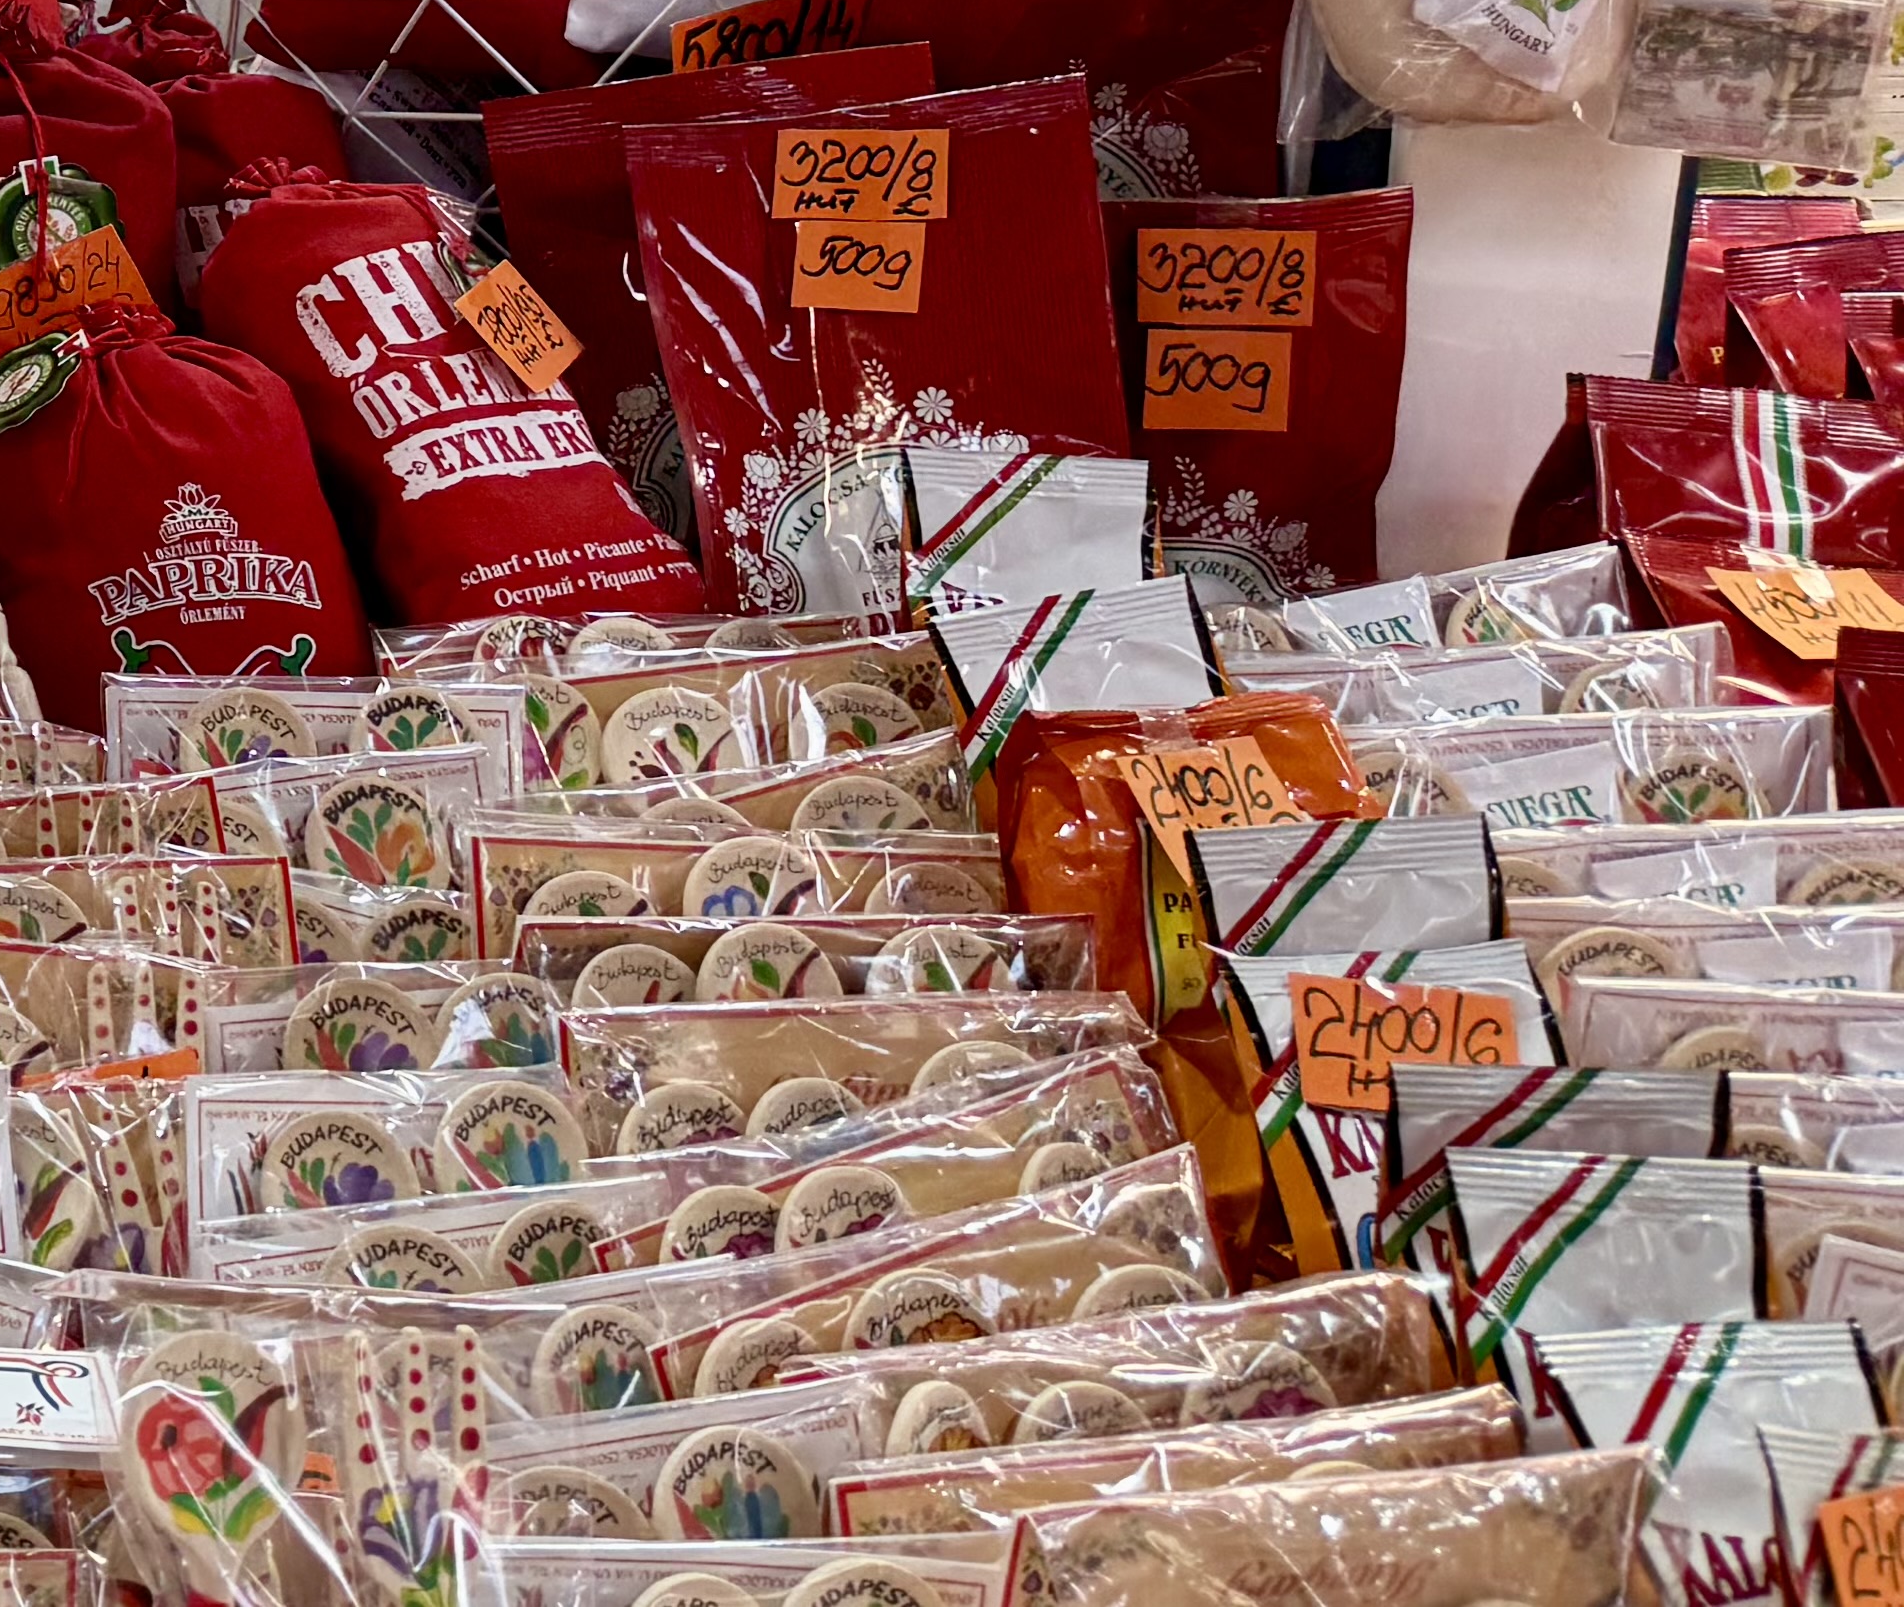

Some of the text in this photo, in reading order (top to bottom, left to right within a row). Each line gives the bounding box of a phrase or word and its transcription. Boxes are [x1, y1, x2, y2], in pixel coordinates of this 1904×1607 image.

[1480, 0, 1559, 58] HUNGARY
[779, 134, 942, 194] 3200/8
[799, 239, 913, 291] 500g
[1137, 236, 1310, 309] 3200/8
[1144, 345, 1273, 414] 500g
[421, 422, 541, 478] EXTRA
[166, 516, 235, 537] HUNGARY
[536, 547, 572, 569] Hot
[583, 538, 647, 564] Picante
[588, 563, 658, 592] Piquant
[88, 550, 322, 626] PAPRIKA
[494, 574, 575, 610] Острый
[180, 605, 246, 626] ŐRLEMÉNY
[201, 699, 297, 744] BUDAPEST
[320, 782, 427, 829] BUDAPEST
[1638, 765, 1744, 803] BUDAPEST
[1555, 943, 1666, 977] BUDAPEST
[312, 994, 418, 1039] BUDAPEST
[1303, 983, 1503, 1066] 2400/6
[453, 1094, 555, 1148] BUDAPEST
[277, 1124, 385, 1173] BUDAPEST
[673, 1438, 779, 1497] BUDAPEST
